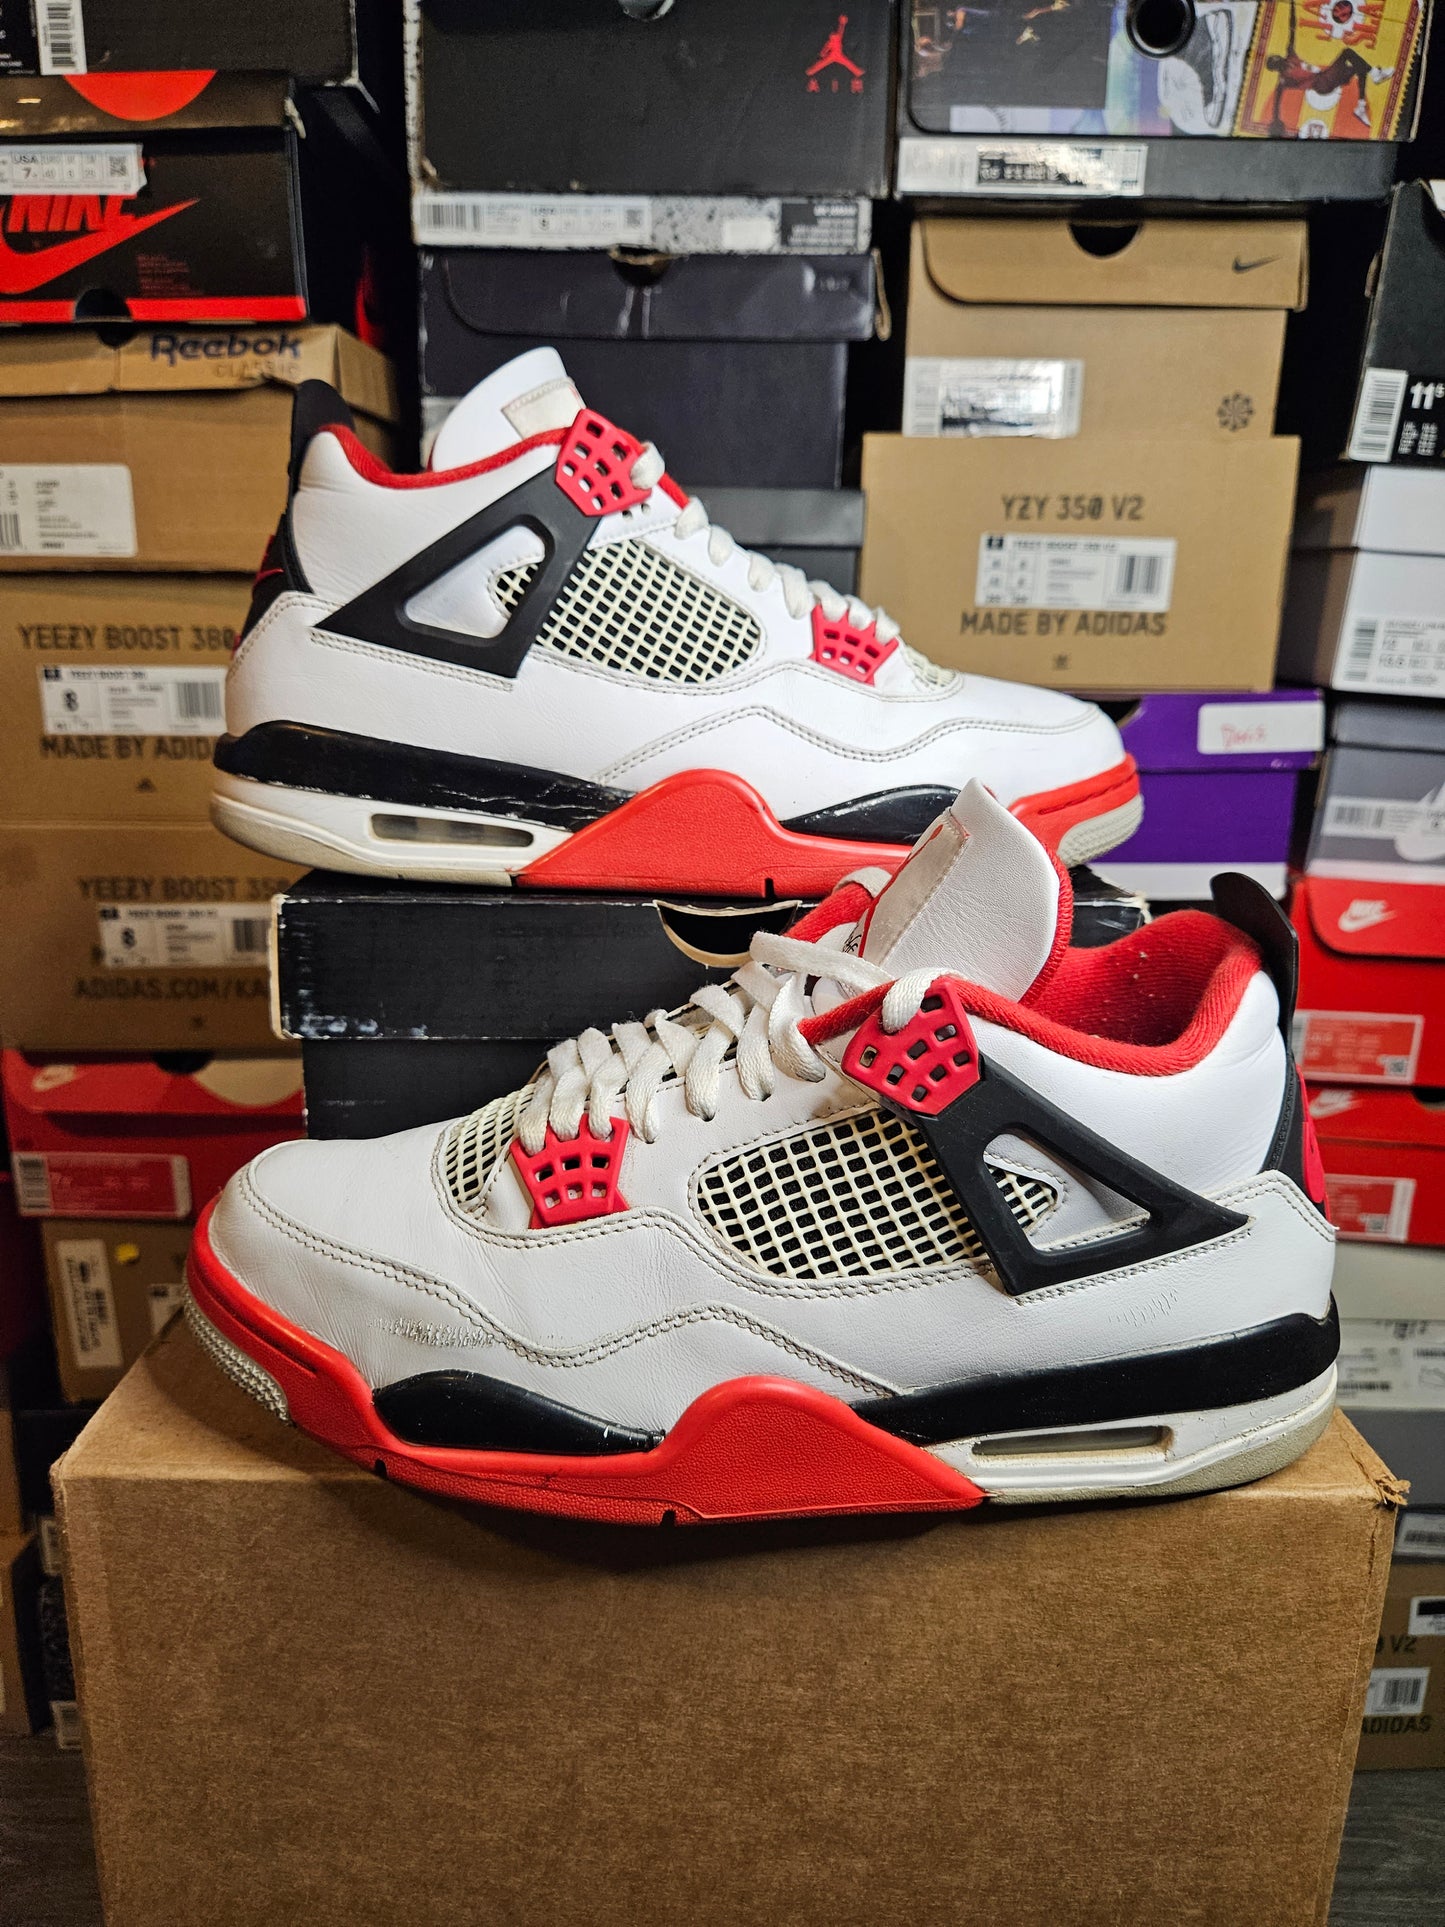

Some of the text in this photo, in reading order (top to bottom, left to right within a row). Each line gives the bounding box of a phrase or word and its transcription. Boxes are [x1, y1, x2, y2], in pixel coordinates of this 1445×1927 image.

[152, 333, 301, 367] Reebok
[1002, 495, 1145, 520] YZY 350 V2
[19, 623, 97, 650] YEEZY
[105, 625, 182, 650] BOOST
[961, 612, 1167, 636] MADE BY ADIDAS
[40, 735, 109, 760] MADE
[115, 736, 146, 760] BY
[79, 877, 151, 898] YEEZY
[163, 877, 236, 899] BOOST
[1391, 1635, 1418, 1652] V2
